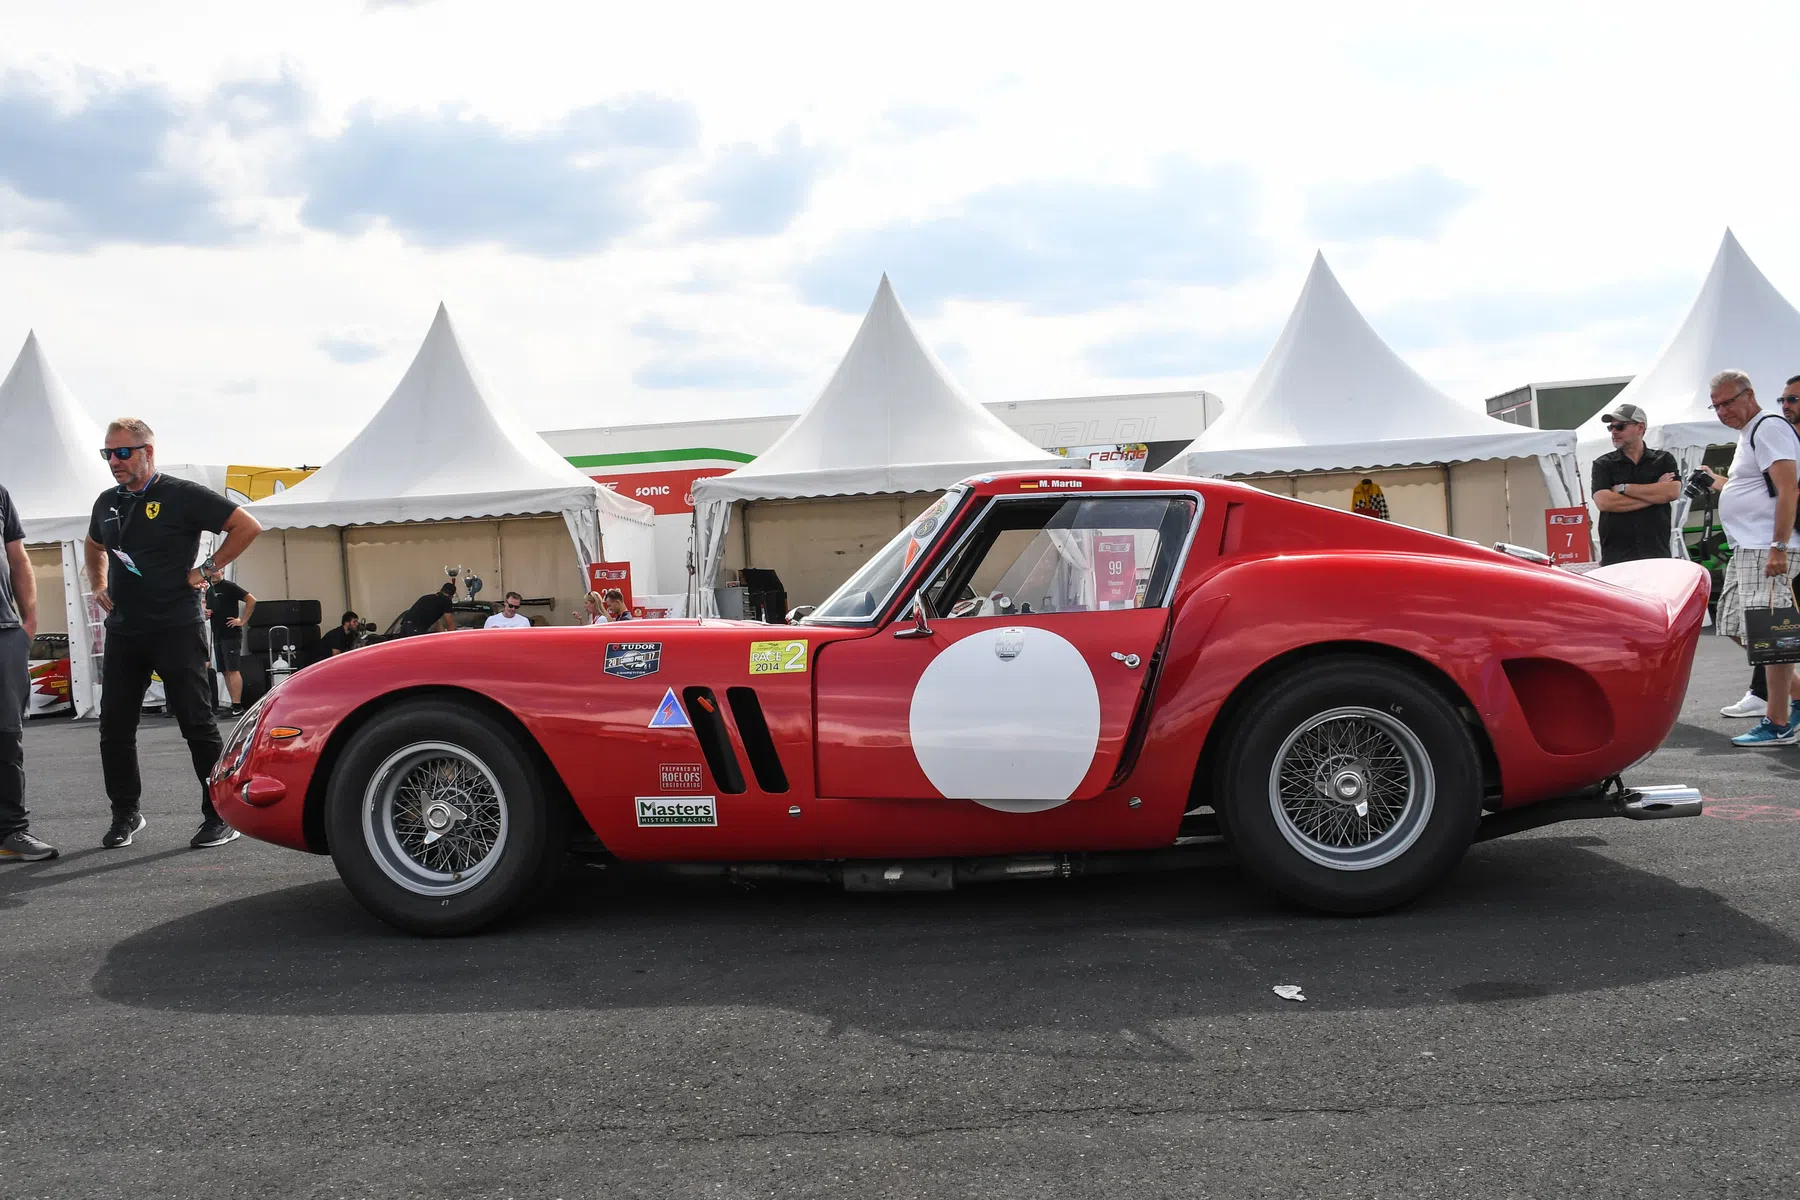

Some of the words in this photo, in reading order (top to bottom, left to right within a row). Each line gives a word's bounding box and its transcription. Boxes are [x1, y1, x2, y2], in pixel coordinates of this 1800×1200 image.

[1039, 480, 1049, 488] M.
[1051, 480, 1082, 488] Martin
[1566, 533, 1573, 547] 7
[1108, 560, 1122, 575] 99
[752, 651, 782, 662] RACE
[784, 642, 806, 670] 2
[755, 662, 779, 671] 2014
[662, 772, 700, 782] ROELOFS
[640, 801, 711, 816] Masters
